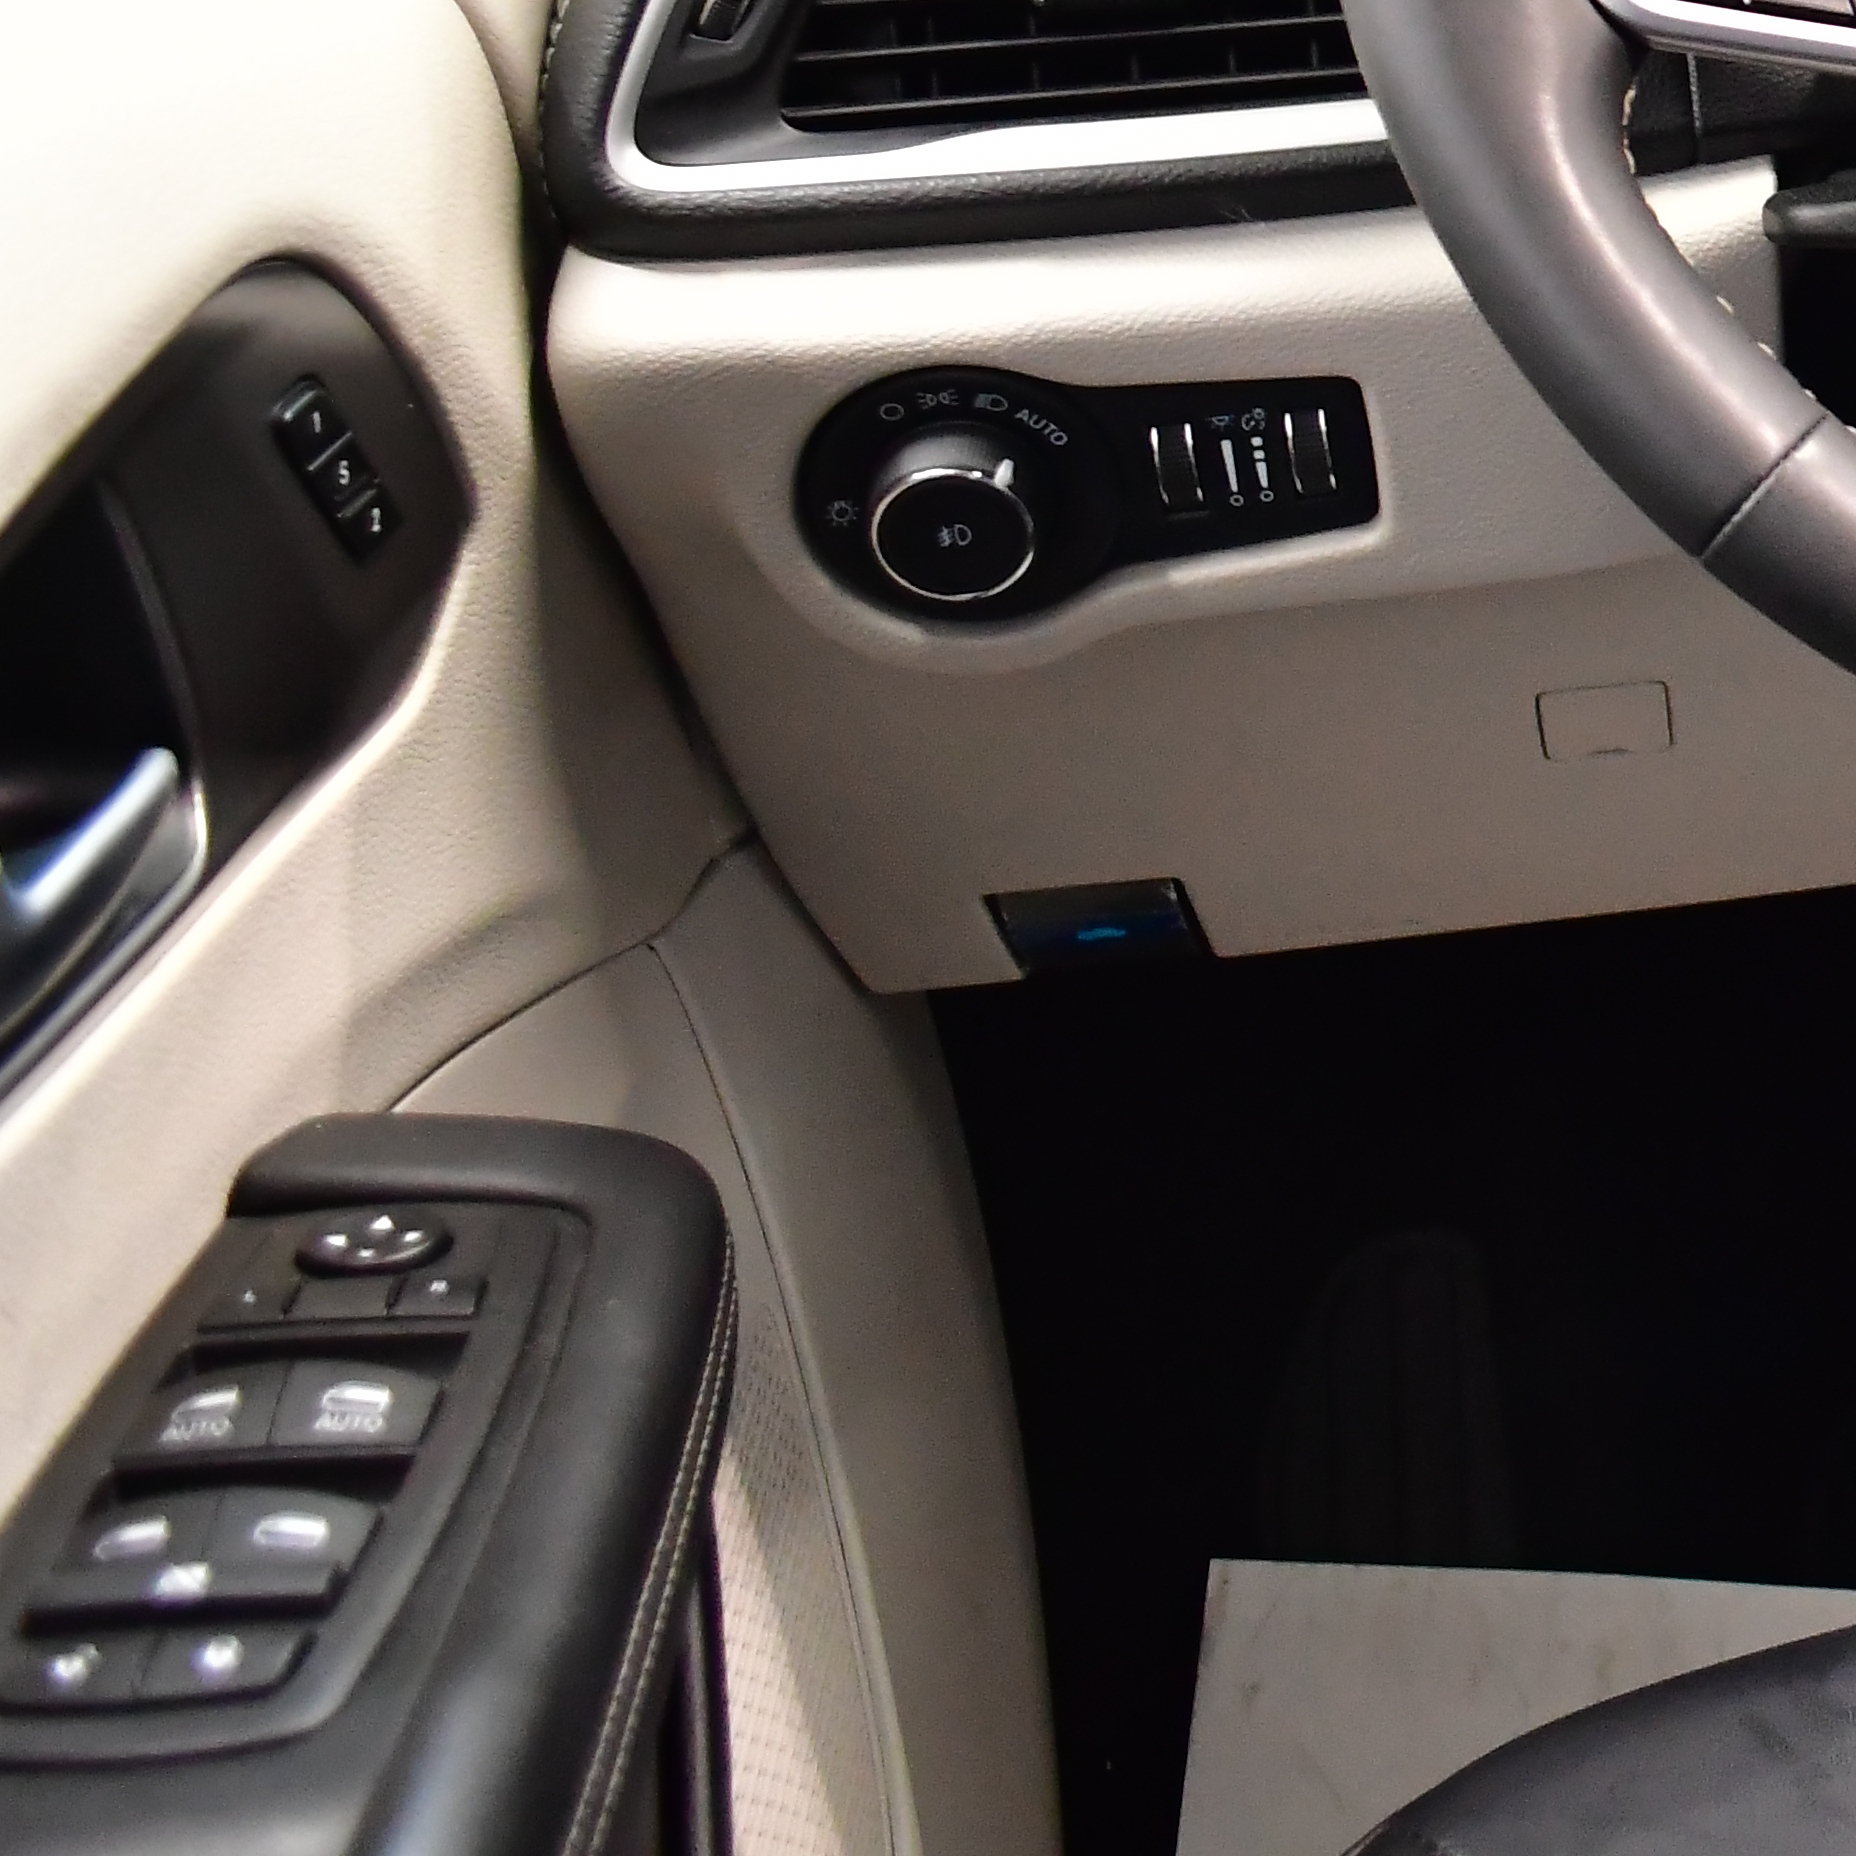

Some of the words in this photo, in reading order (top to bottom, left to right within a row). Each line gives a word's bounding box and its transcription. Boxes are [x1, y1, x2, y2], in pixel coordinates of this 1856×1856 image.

[1013, 408, 1068, 446] AUTO
[158, 1415, 235, 1442] AUTO
[313, 1411, 386, 1434] AUTO
